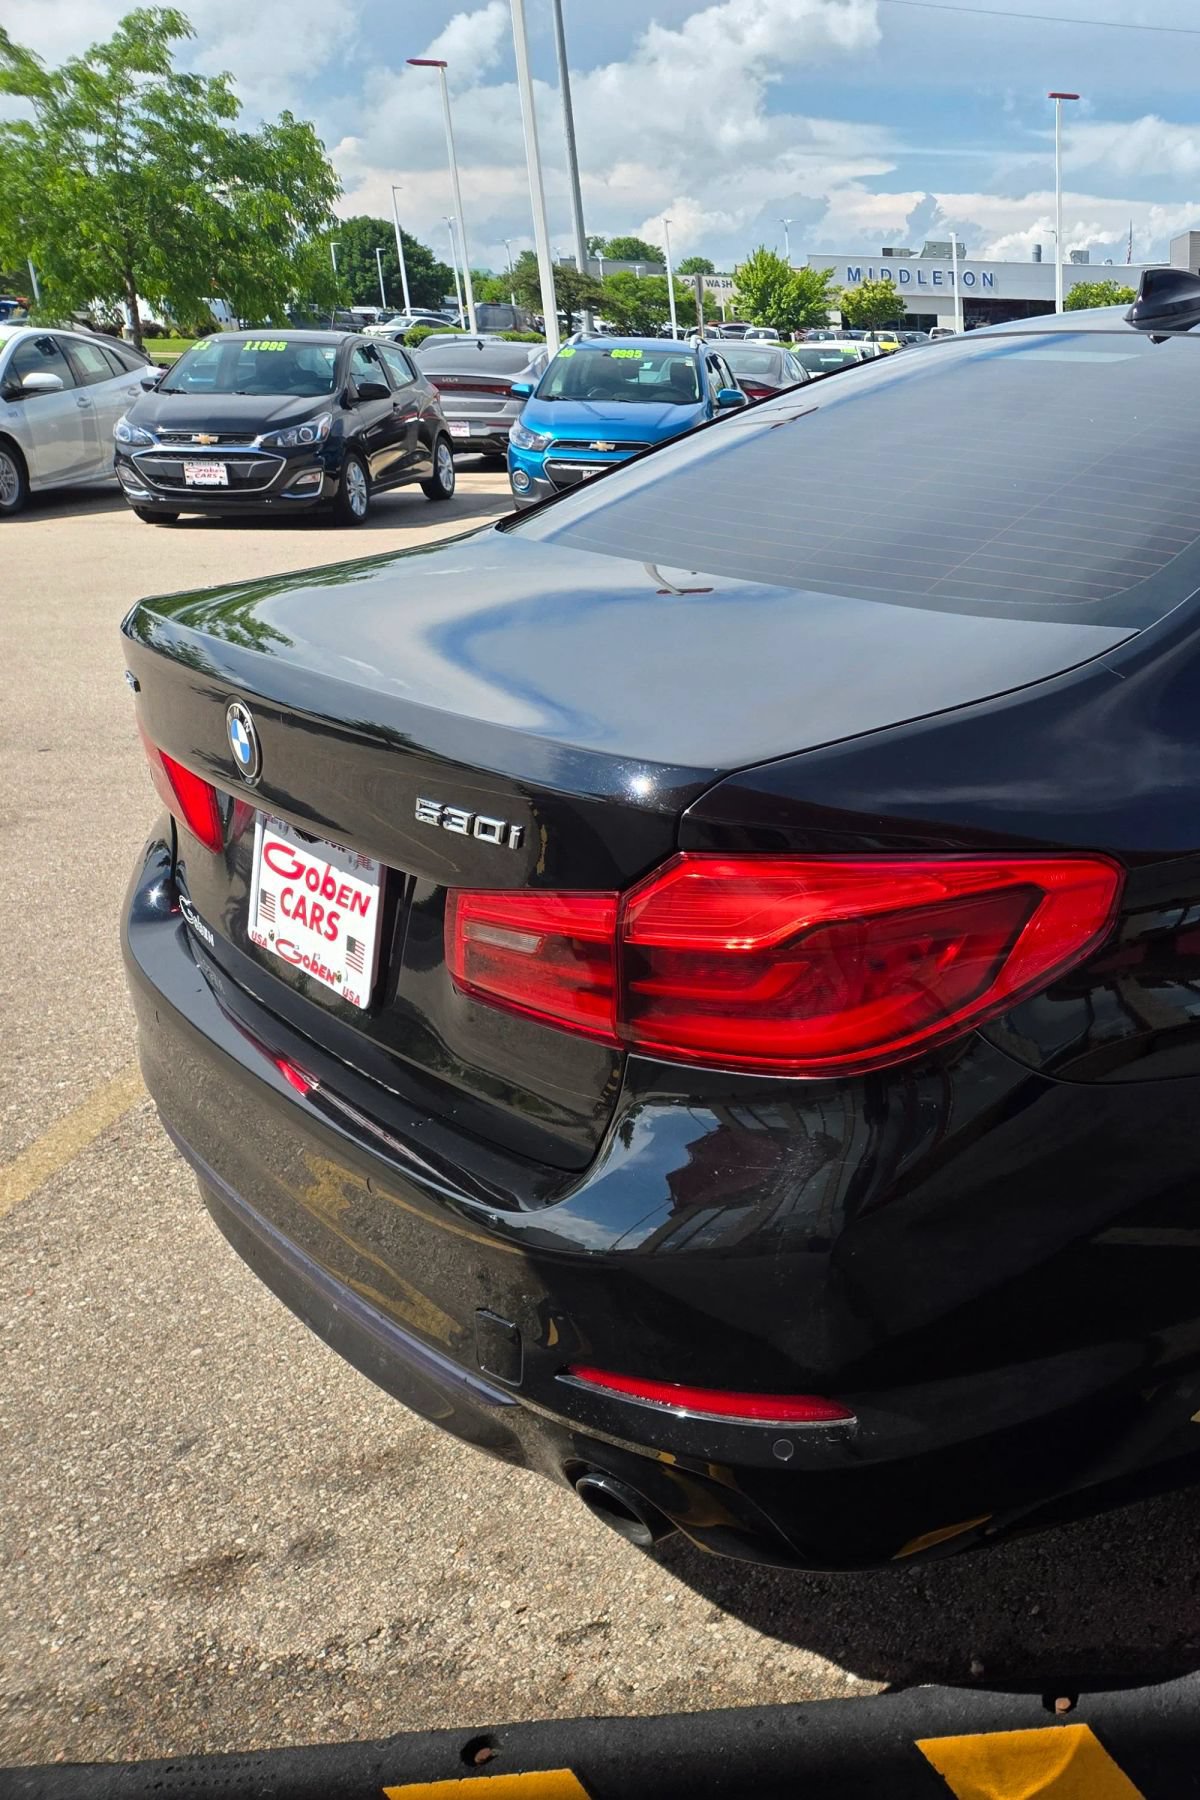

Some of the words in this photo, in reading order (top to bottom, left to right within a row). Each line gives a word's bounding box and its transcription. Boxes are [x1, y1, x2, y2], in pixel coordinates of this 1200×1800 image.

[705, 279, 733, 288] WASH
[847, 267, 995, 288] MIDDLETON
[243, 340, 289, 351] 11995
[415, 797, 524, 850] 530i
[280, 887, 341, 942] CARS
[251, 930, 268, 949] USA
[342, 985, 361, 1007] USA
